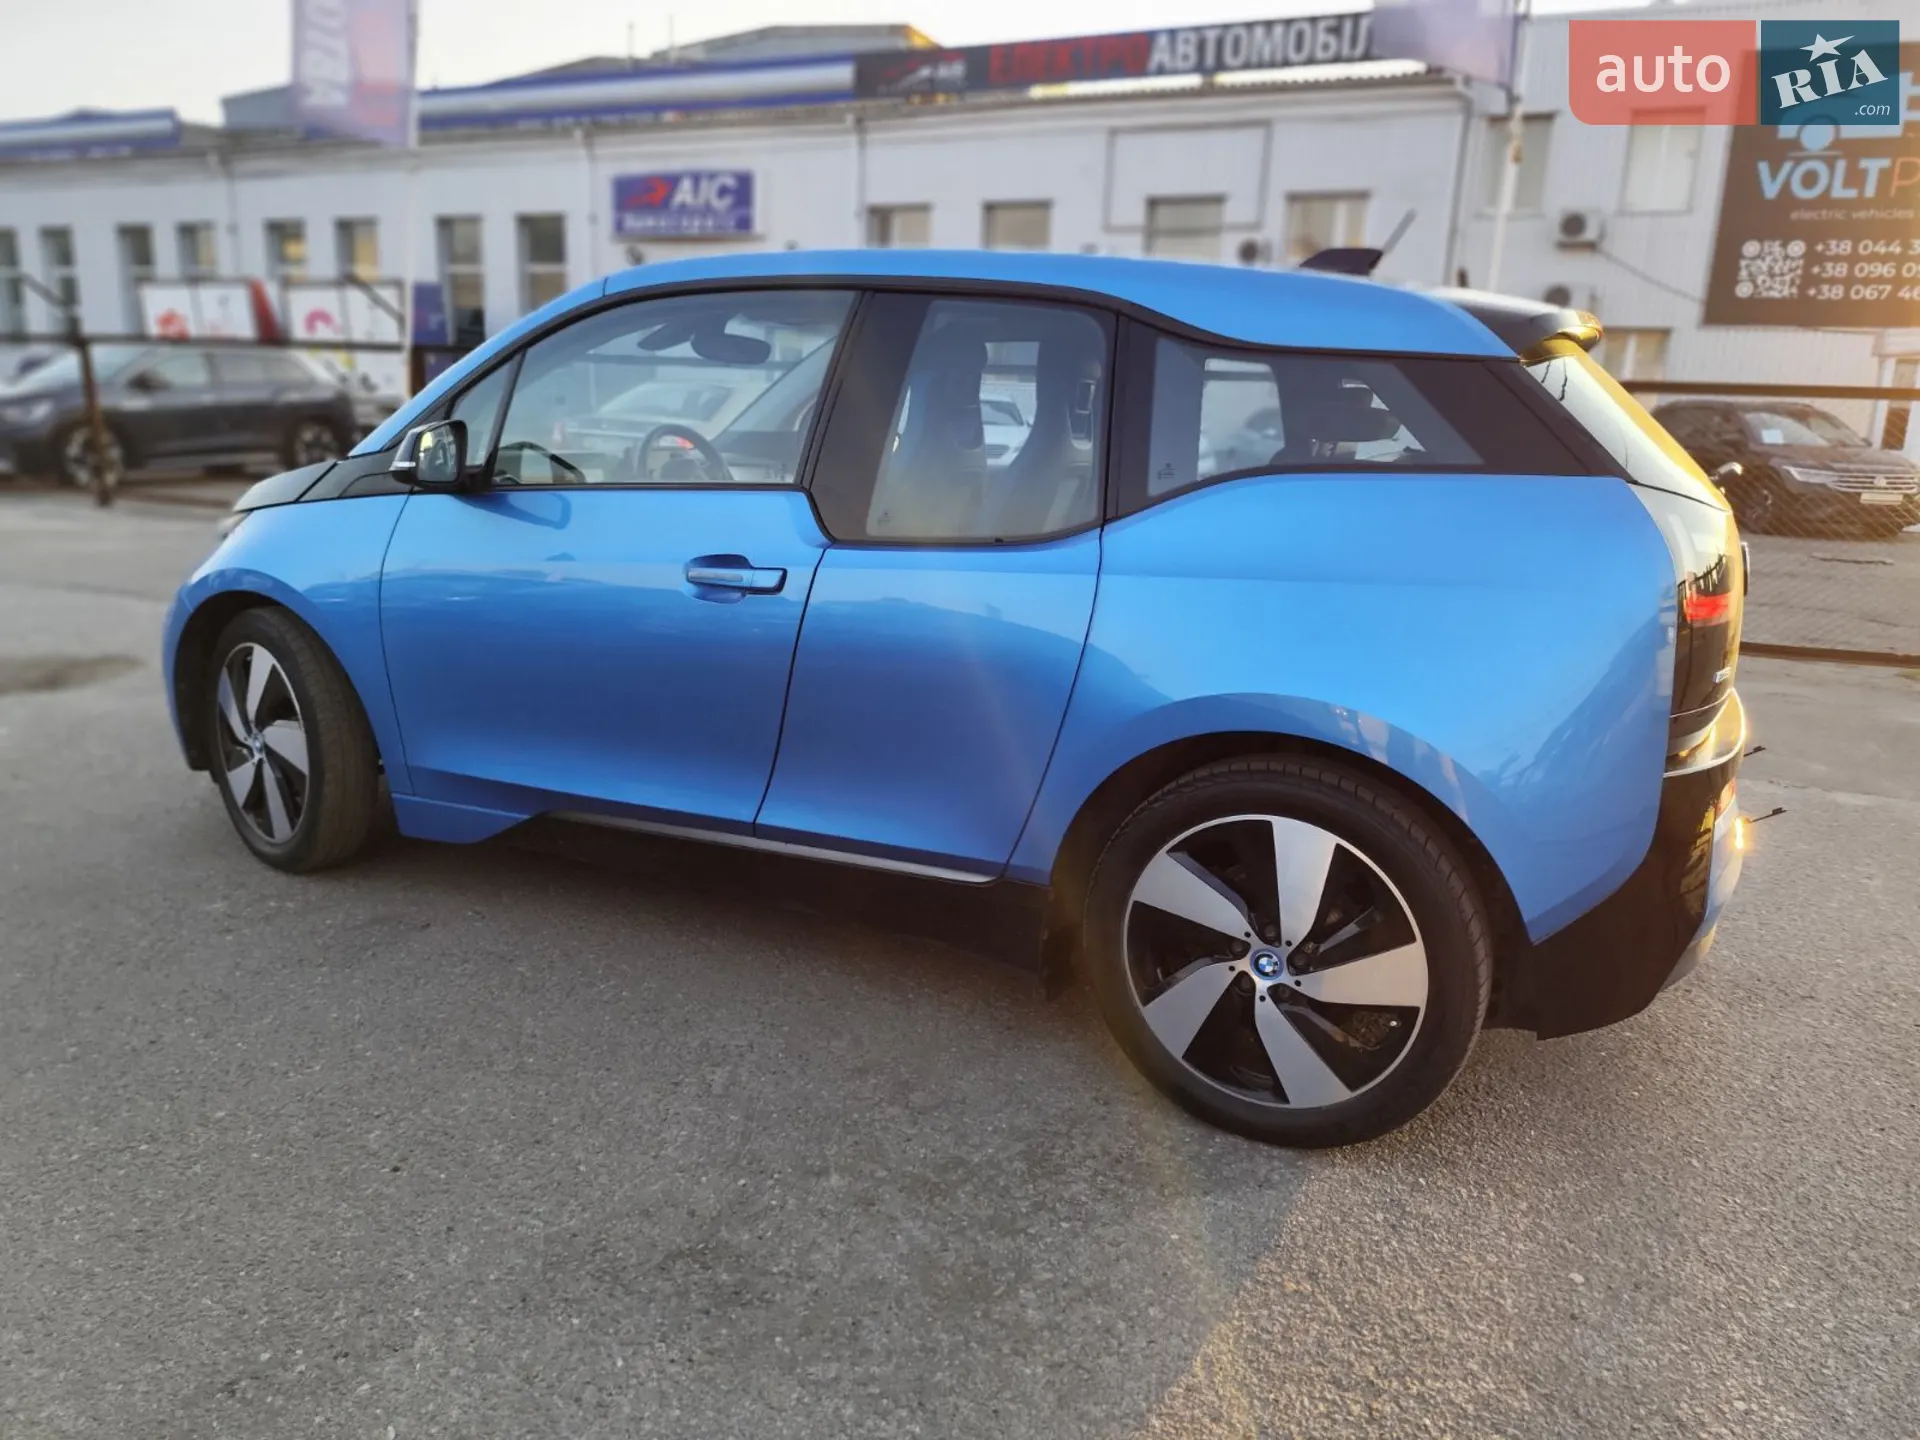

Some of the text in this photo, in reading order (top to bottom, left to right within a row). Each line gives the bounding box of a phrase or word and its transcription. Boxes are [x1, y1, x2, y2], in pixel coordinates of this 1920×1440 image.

[1790, 207, 1915, 220] electric vehicles
[1813, 239, 1853, 256] +38
[1858, 239, 1903, 256] 044
[1810, 261, 1920, 278] +38 096 0
[1806, 283, 1845, 300] +38
[1850, 283, 1893, 300] 067
